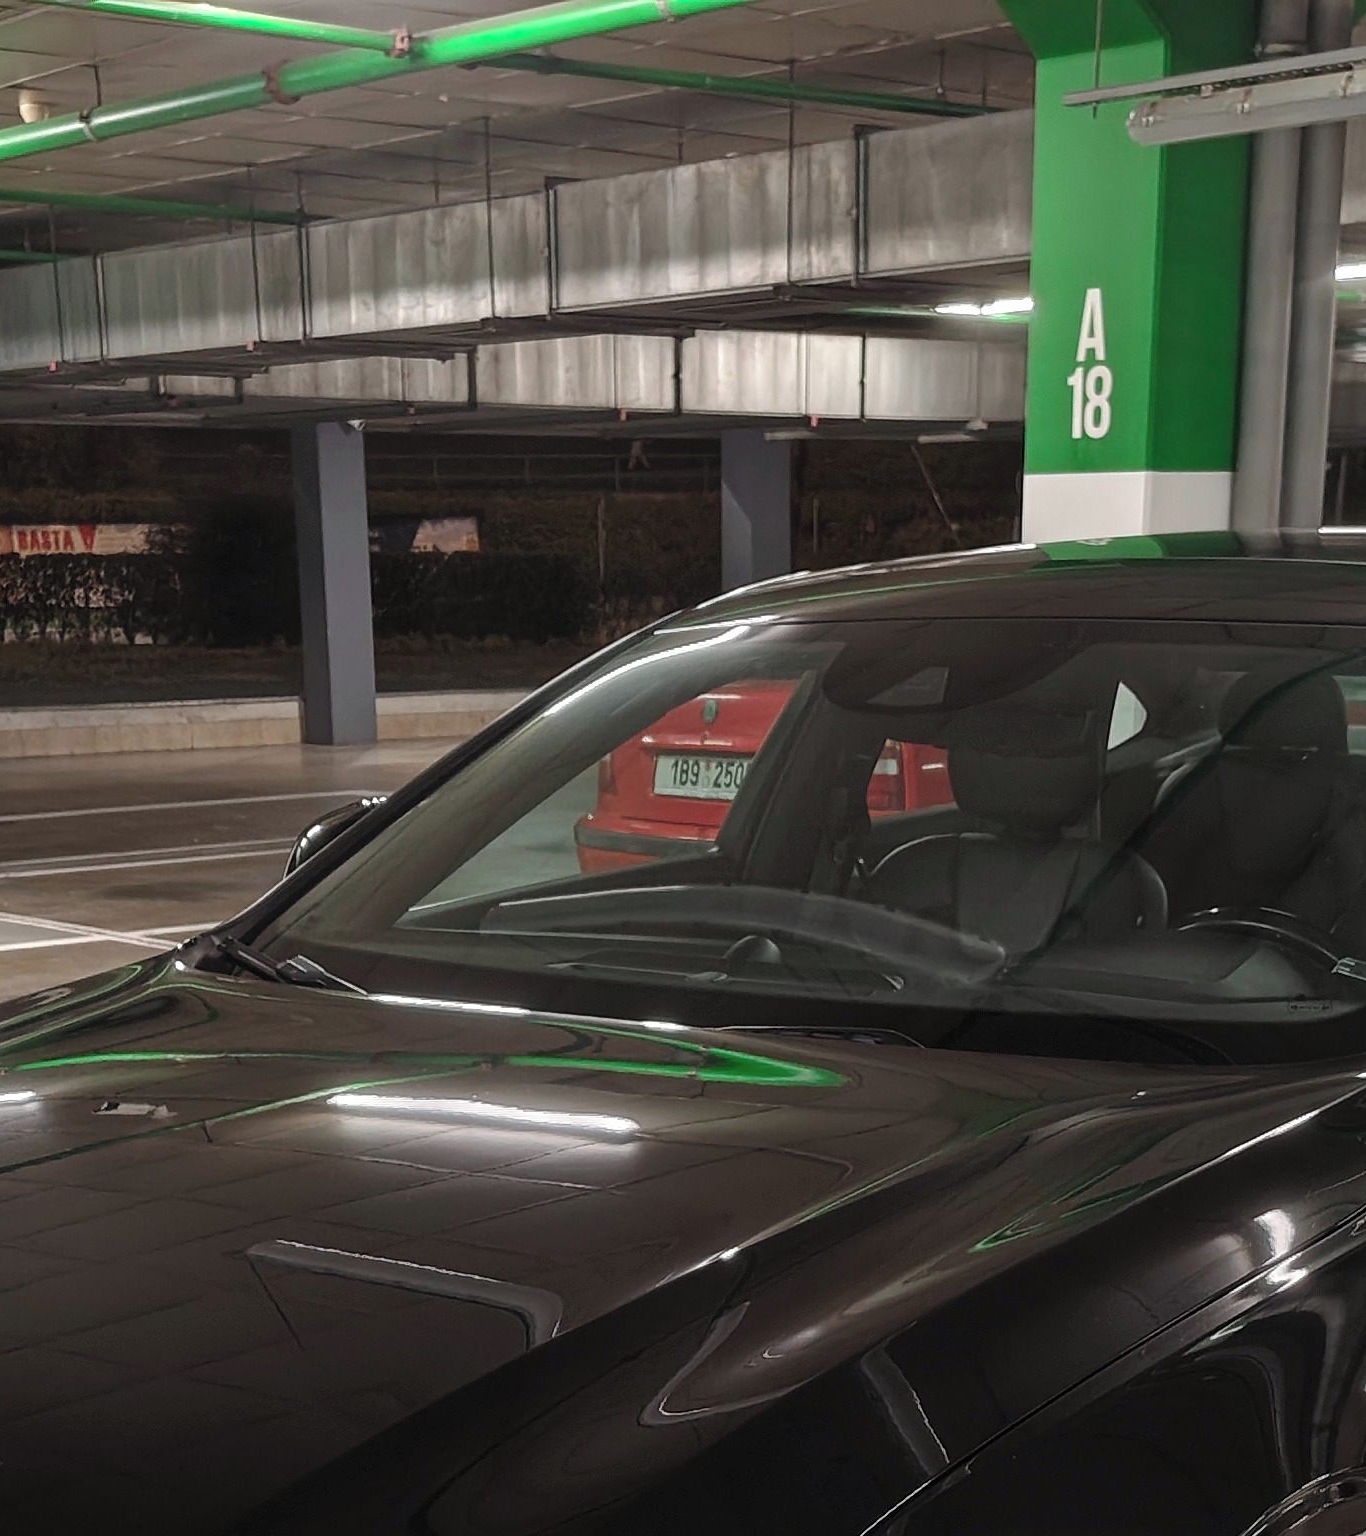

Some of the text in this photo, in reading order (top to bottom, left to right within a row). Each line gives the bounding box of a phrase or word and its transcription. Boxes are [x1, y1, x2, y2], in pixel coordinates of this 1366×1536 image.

[1076, 288, 1106, 362] A
[1067, 365, 1113, 439] 18
[671, 760, 701, 787] 1B9
